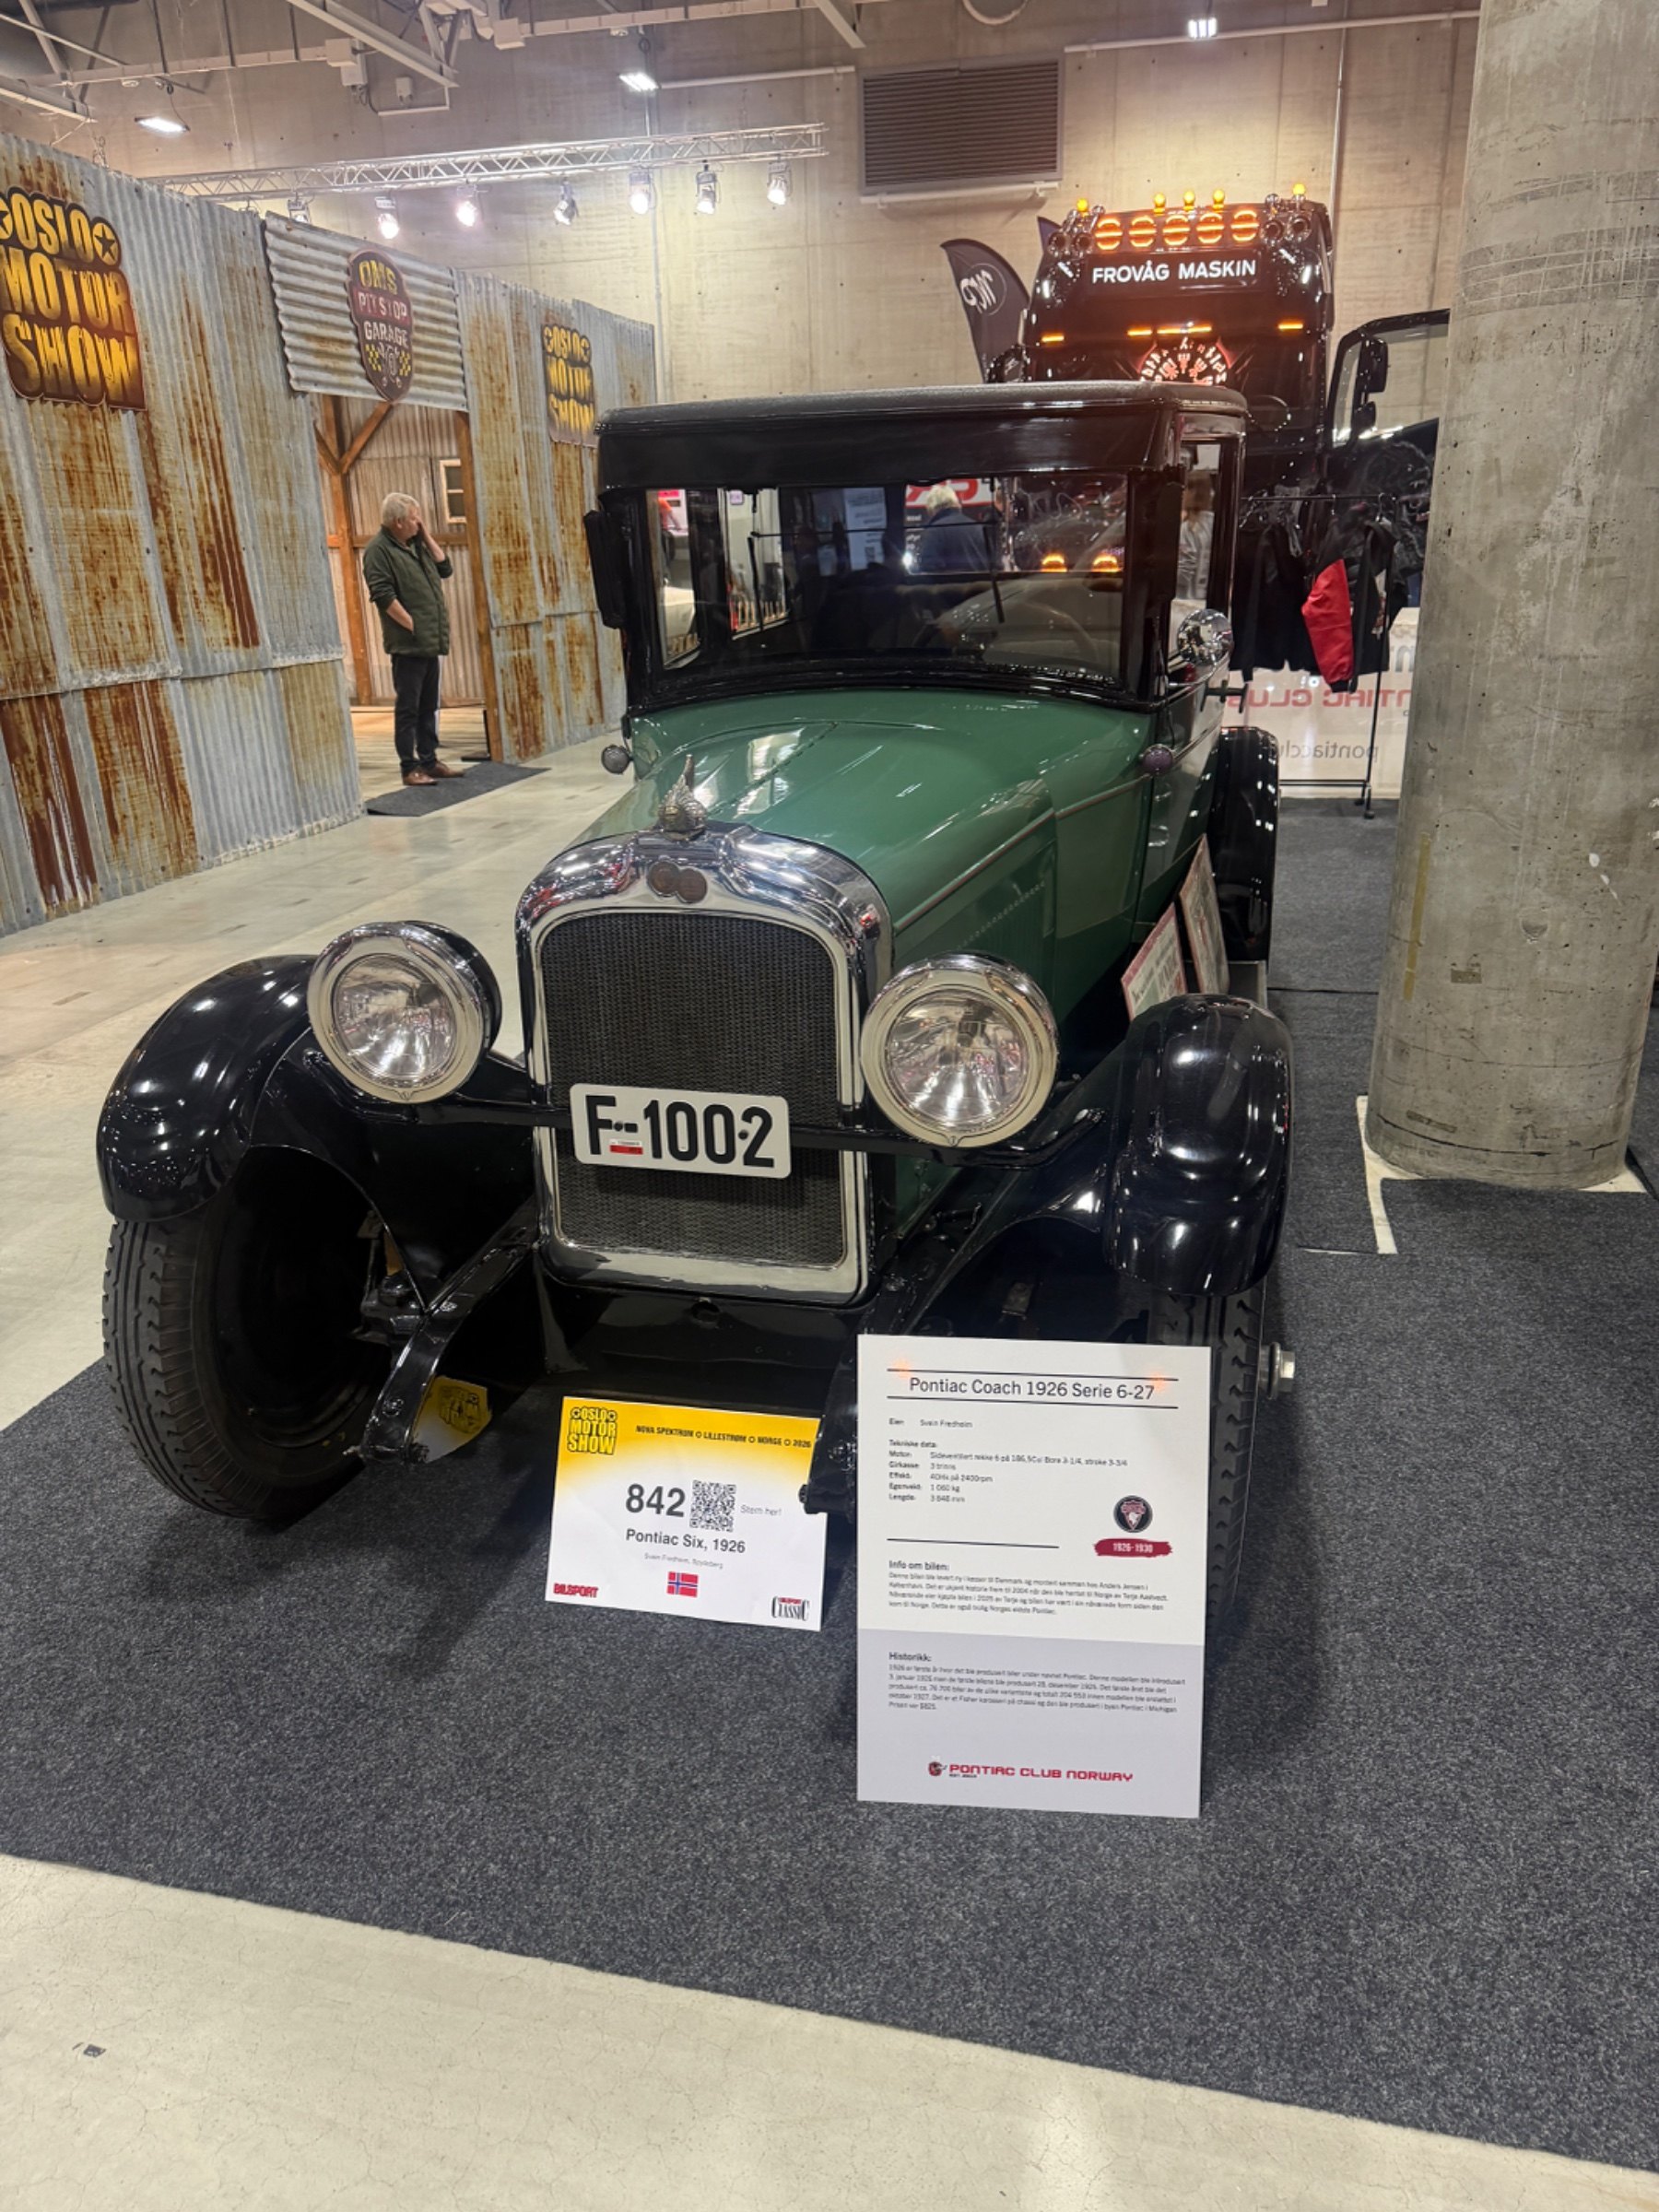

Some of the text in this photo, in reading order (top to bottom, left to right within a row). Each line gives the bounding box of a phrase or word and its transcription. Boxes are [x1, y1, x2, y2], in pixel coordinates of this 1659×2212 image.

[11, 194, 94, 264] OSLO
[1092, 260, 1256, 284] FROVÅG MASKIN
[0, 244, 135, 335] MOTOR
[364, 321, 408, 348] GARAGE
[552, 325, 582, 361] OSLO
[3, 313, 142, 403] SHOW
[547, 355, 592, 402] MOTOR
[548, 393, 594, 442] SHOW
[585, 1095, 774, 1168] F-1002
[910, 1377, 1155, 1400] Pontiac Coach 1926 Serie 6-27
[581, 1407, 607, 1421] OSLO
[570, 1419, 617, 1438] MOTOR
[568, 1433, 616, 1454] SHOW
[793, 1439, 812, 1448] 2026
[626, 1483, 686, 1518] 842
[626, 1528, 747, 1554] Pontiac Six, 1926
[888, 1560, 906, 1569] Info
[924, 1561, 950, 1571] bilen:
[554, 1583, 598, 1598] BILSPORT
[888, 1652, 932, 1661] Historikk:
[948, 1763, 1016, 1777] PONTIAC
[1019, 1767, 1063, 1780] CLUB
[1066, 1770, 1134, 1783] NORWAY
